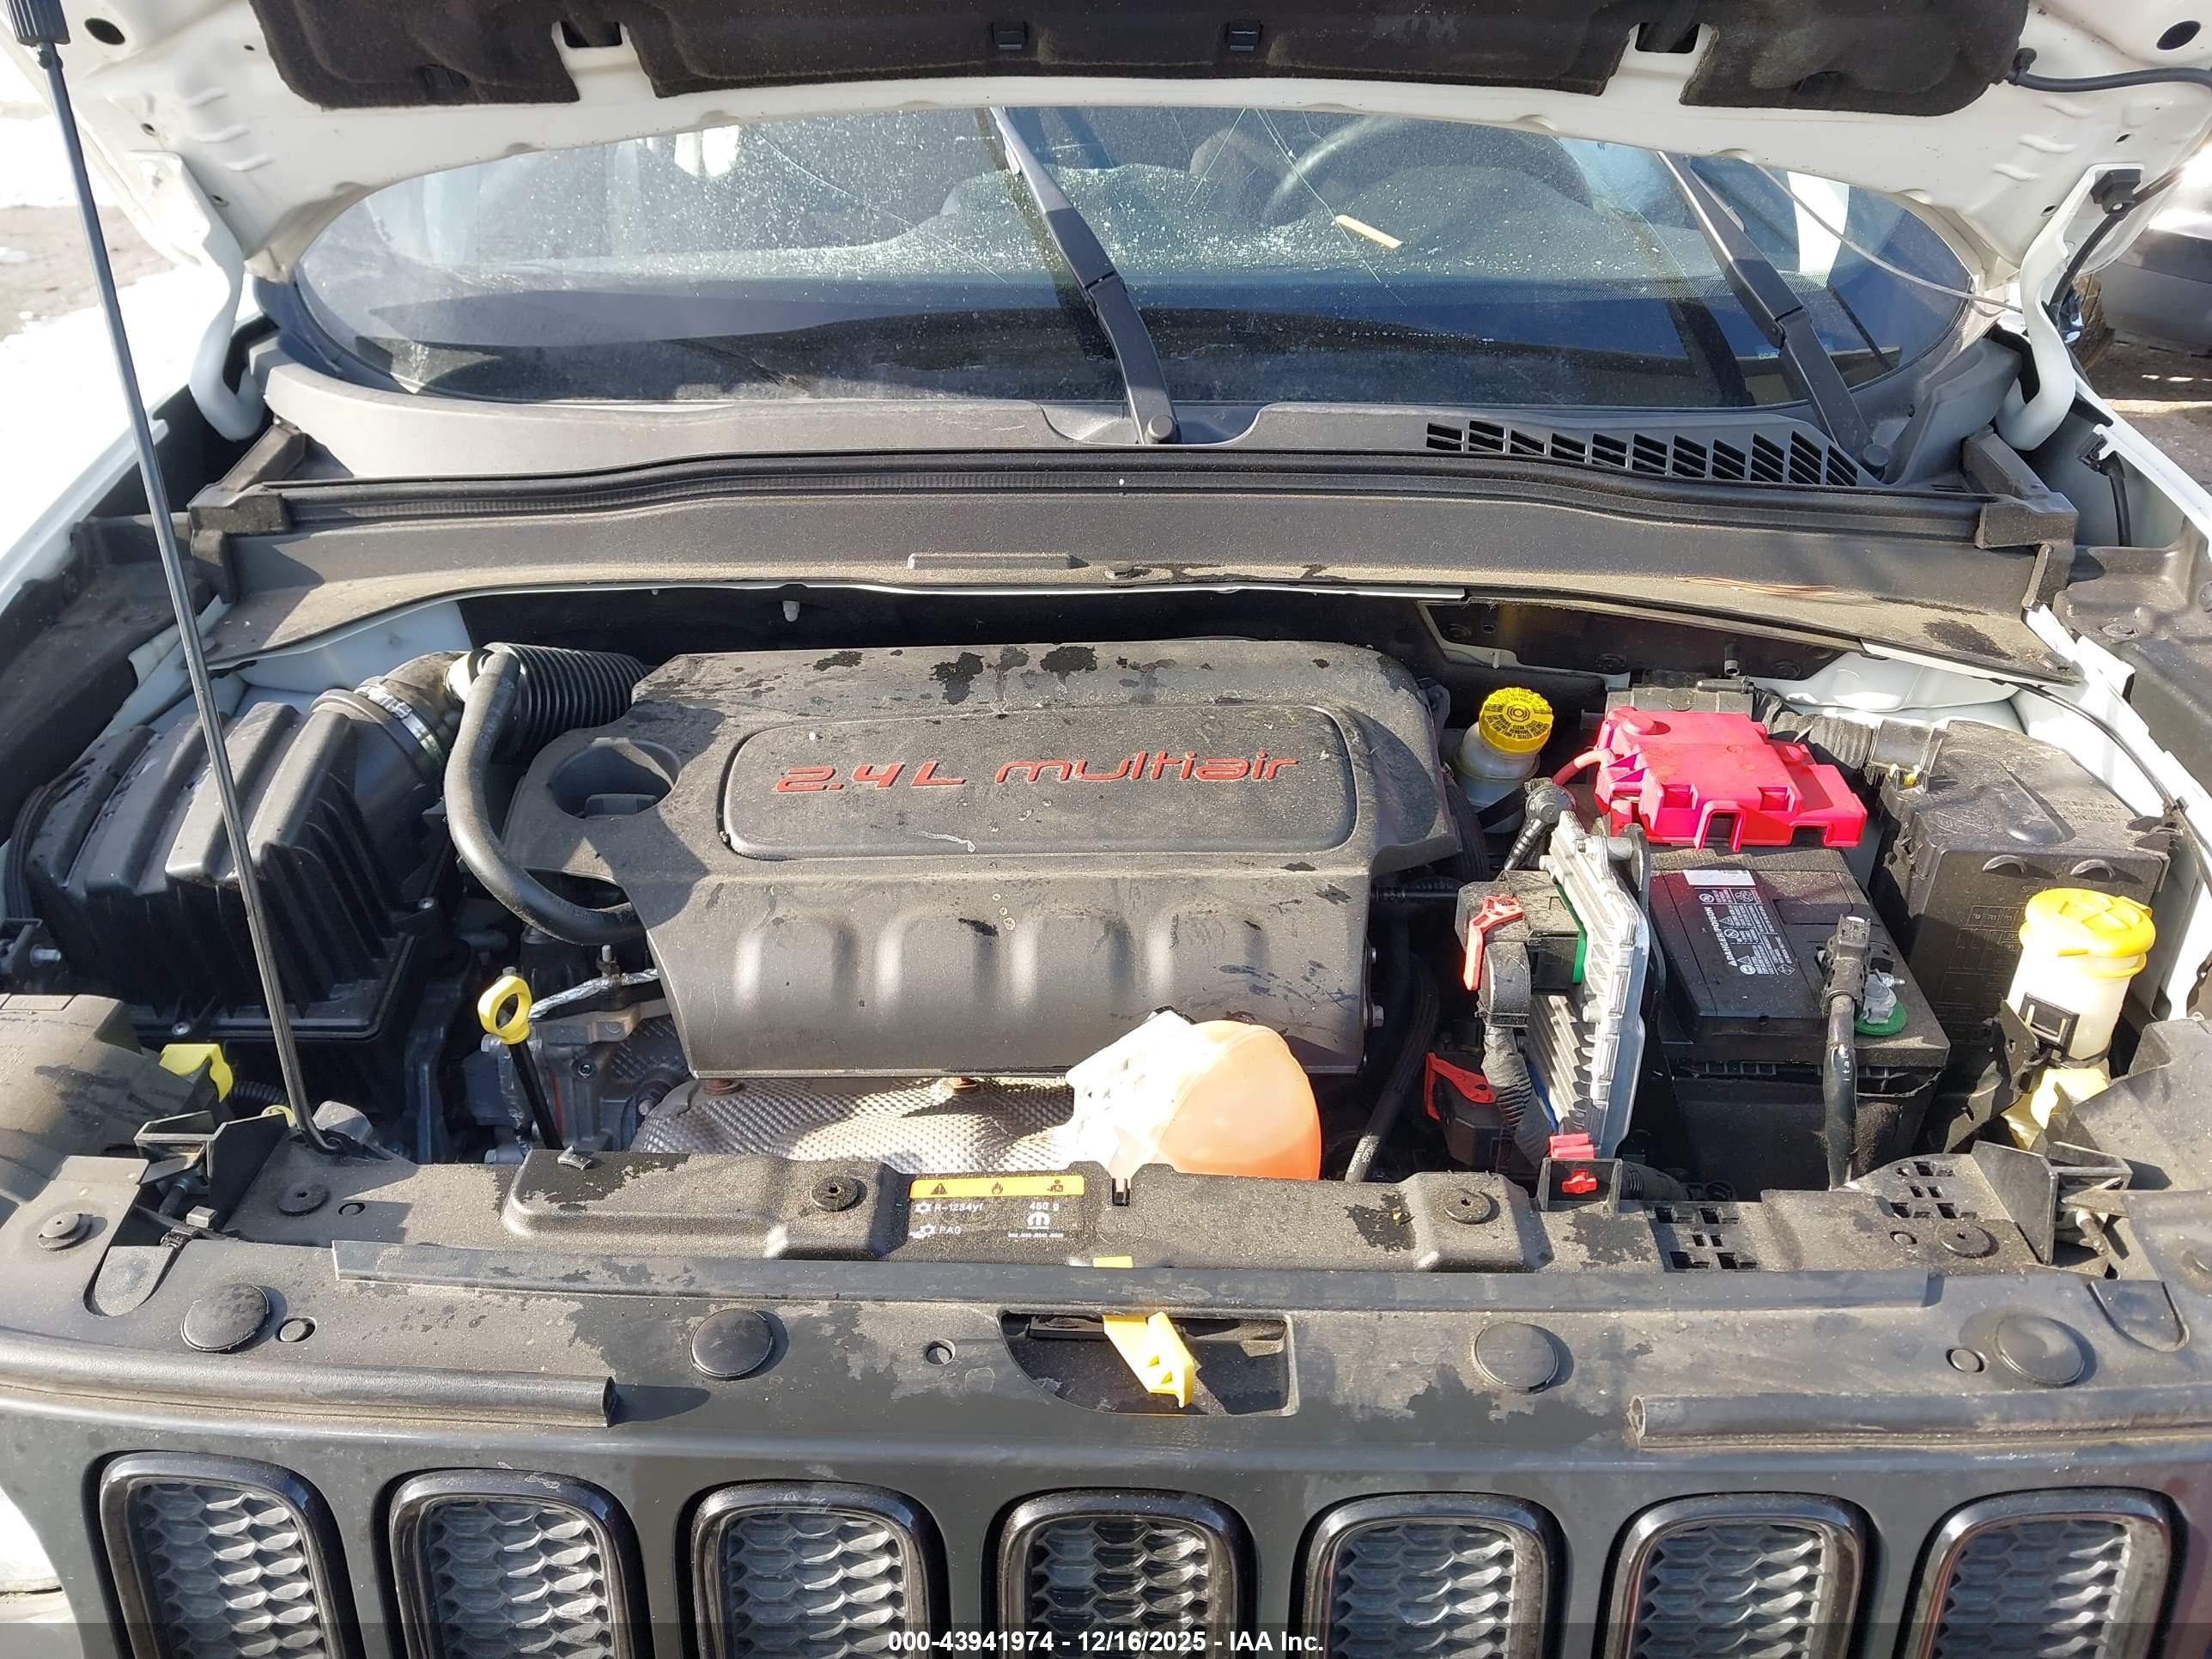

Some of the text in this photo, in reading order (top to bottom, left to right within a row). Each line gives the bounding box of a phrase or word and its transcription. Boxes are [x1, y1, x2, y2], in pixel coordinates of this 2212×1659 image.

[995, 751, 1297, 783] multiair
[1704, 907, 1735, 963] DANGER/POISON
[939, 1225, 961, 1235] PAG
